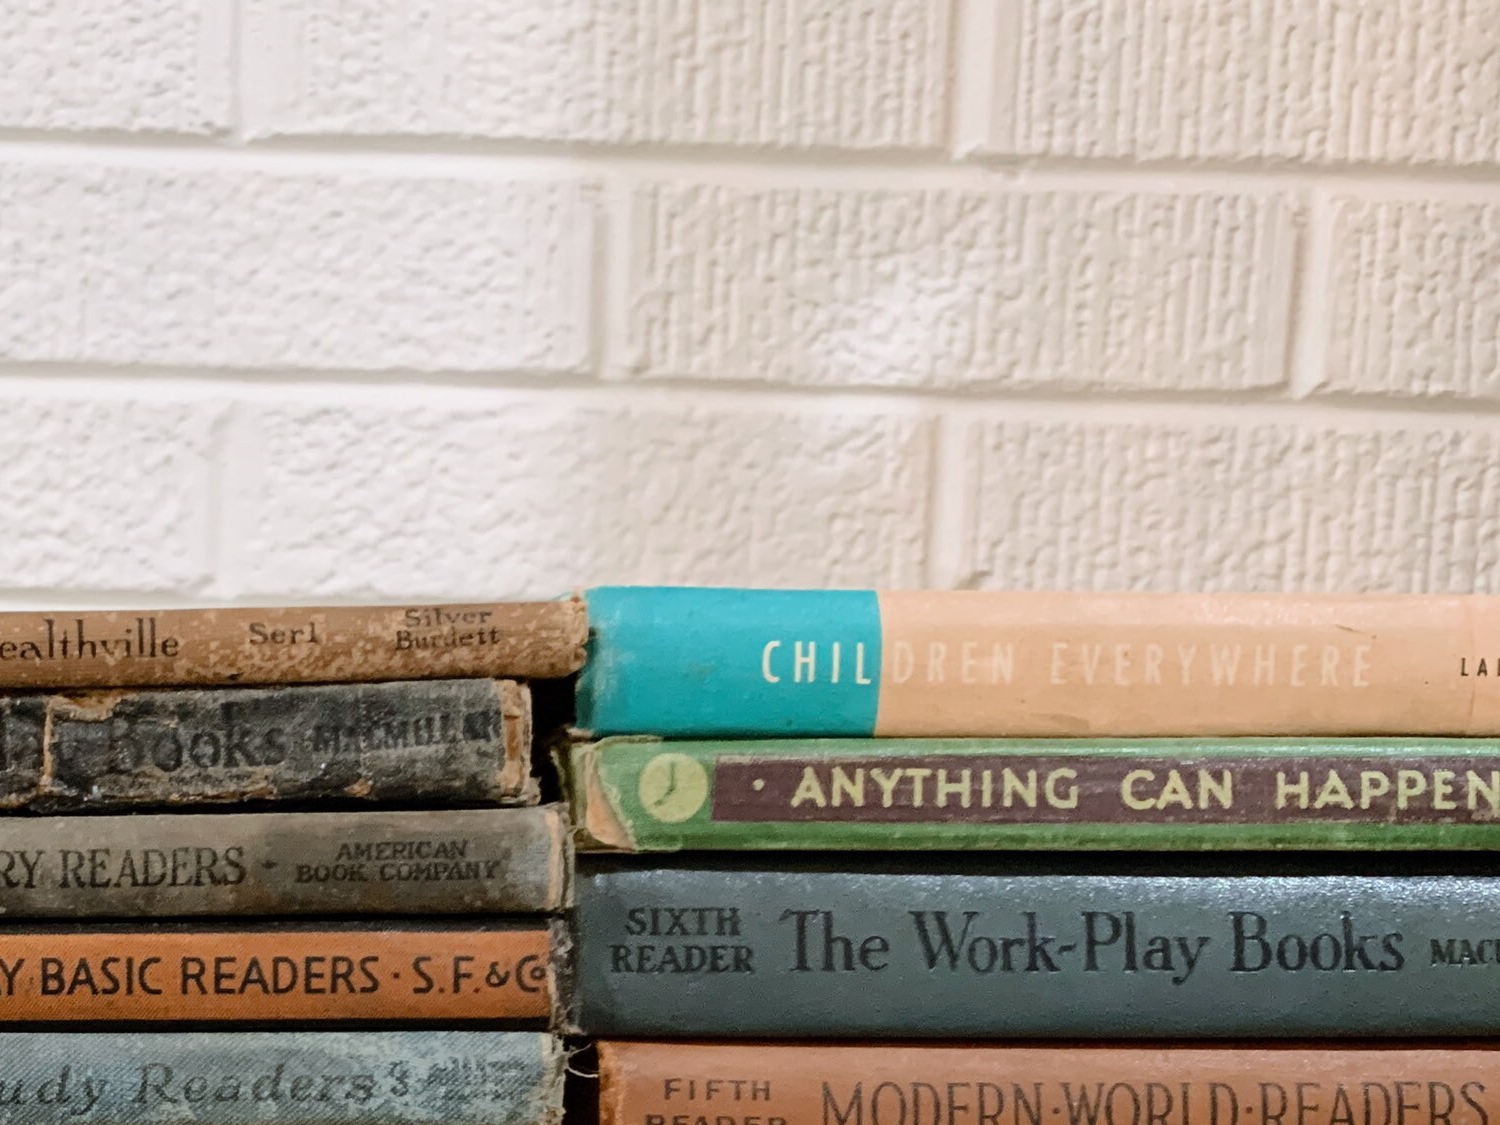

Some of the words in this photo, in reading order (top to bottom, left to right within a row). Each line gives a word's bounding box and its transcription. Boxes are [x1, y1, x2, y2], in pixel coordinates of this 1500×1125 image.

[404, 607, 493, 628] Silver
[395, 624, 500, 651] Burdett
[761, 640, 1016, 686] CHILDREN
[1049, 643, 1373, 688] EVERYWHERE
[789, 766, 1080, 810] ANYTHING
[1120, 768, 1234, 811] CAN
[1275, 768, 1500, 814] HAPPEN
[334, 840, 470, 861] AMERICAN
[58, 845, 248, 890] READERS
[294, 862, 368, 884] BOOK
[379, 860, 500, 883] COMPANY
[623, 906, 742, 937] SIXTH
[608, 944, 756, 975] READER
[778, 909, 891, 973] The
[908, 909, 1212, 987] Work-Play
[1227, 909, 1405, 973] Books
[40, 957, 163, 997] BASIC
[180, 956, 381, 996] READERS
[133, 1061, 378, 1105] Readers
[663, 1078, 772, 1102] FIFTH
